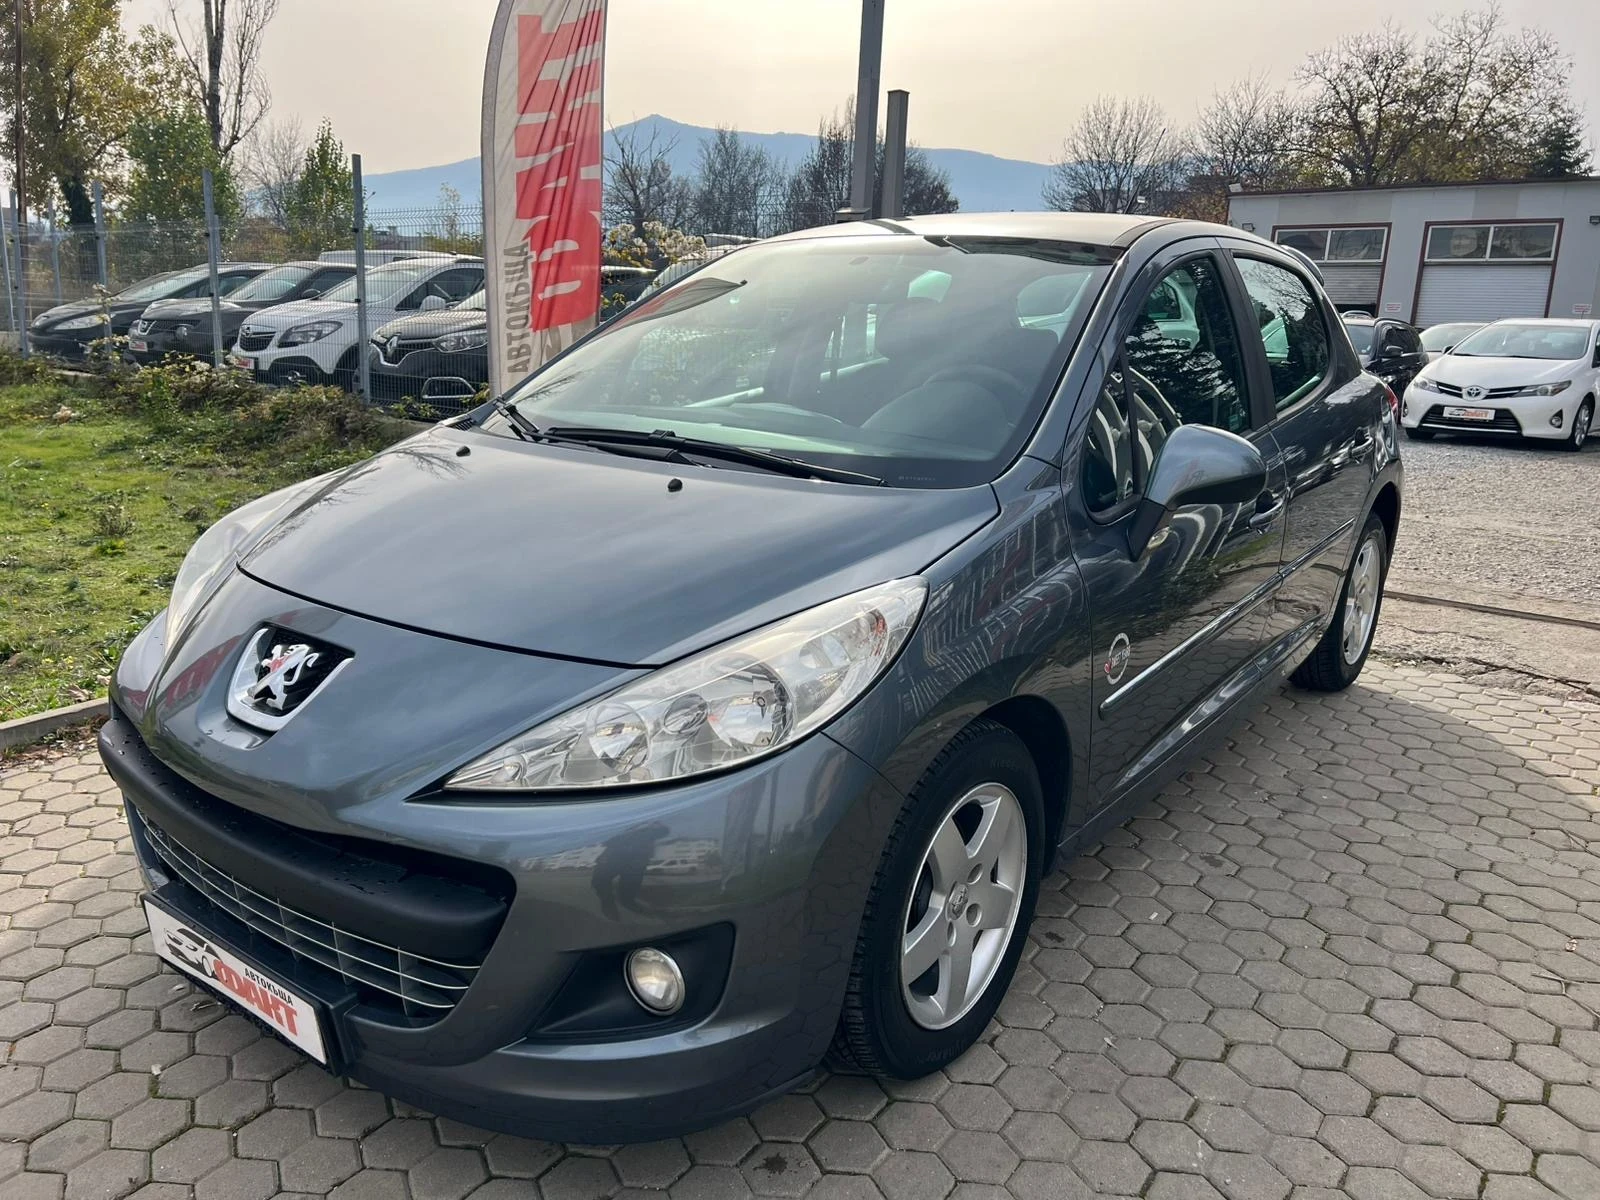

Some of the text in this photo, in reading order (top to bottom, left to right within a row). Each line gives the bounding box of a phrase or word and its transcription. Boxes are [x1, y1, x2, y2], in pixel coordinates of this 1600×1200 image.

[515, 8, 603, 332] ФАКТ
[504, 242, 535, 373] АВТОКЪЩА
[213, 959, 298, 1036] ФАКТ
[244, 967, 294, 1006] АВТОКЪЩА
